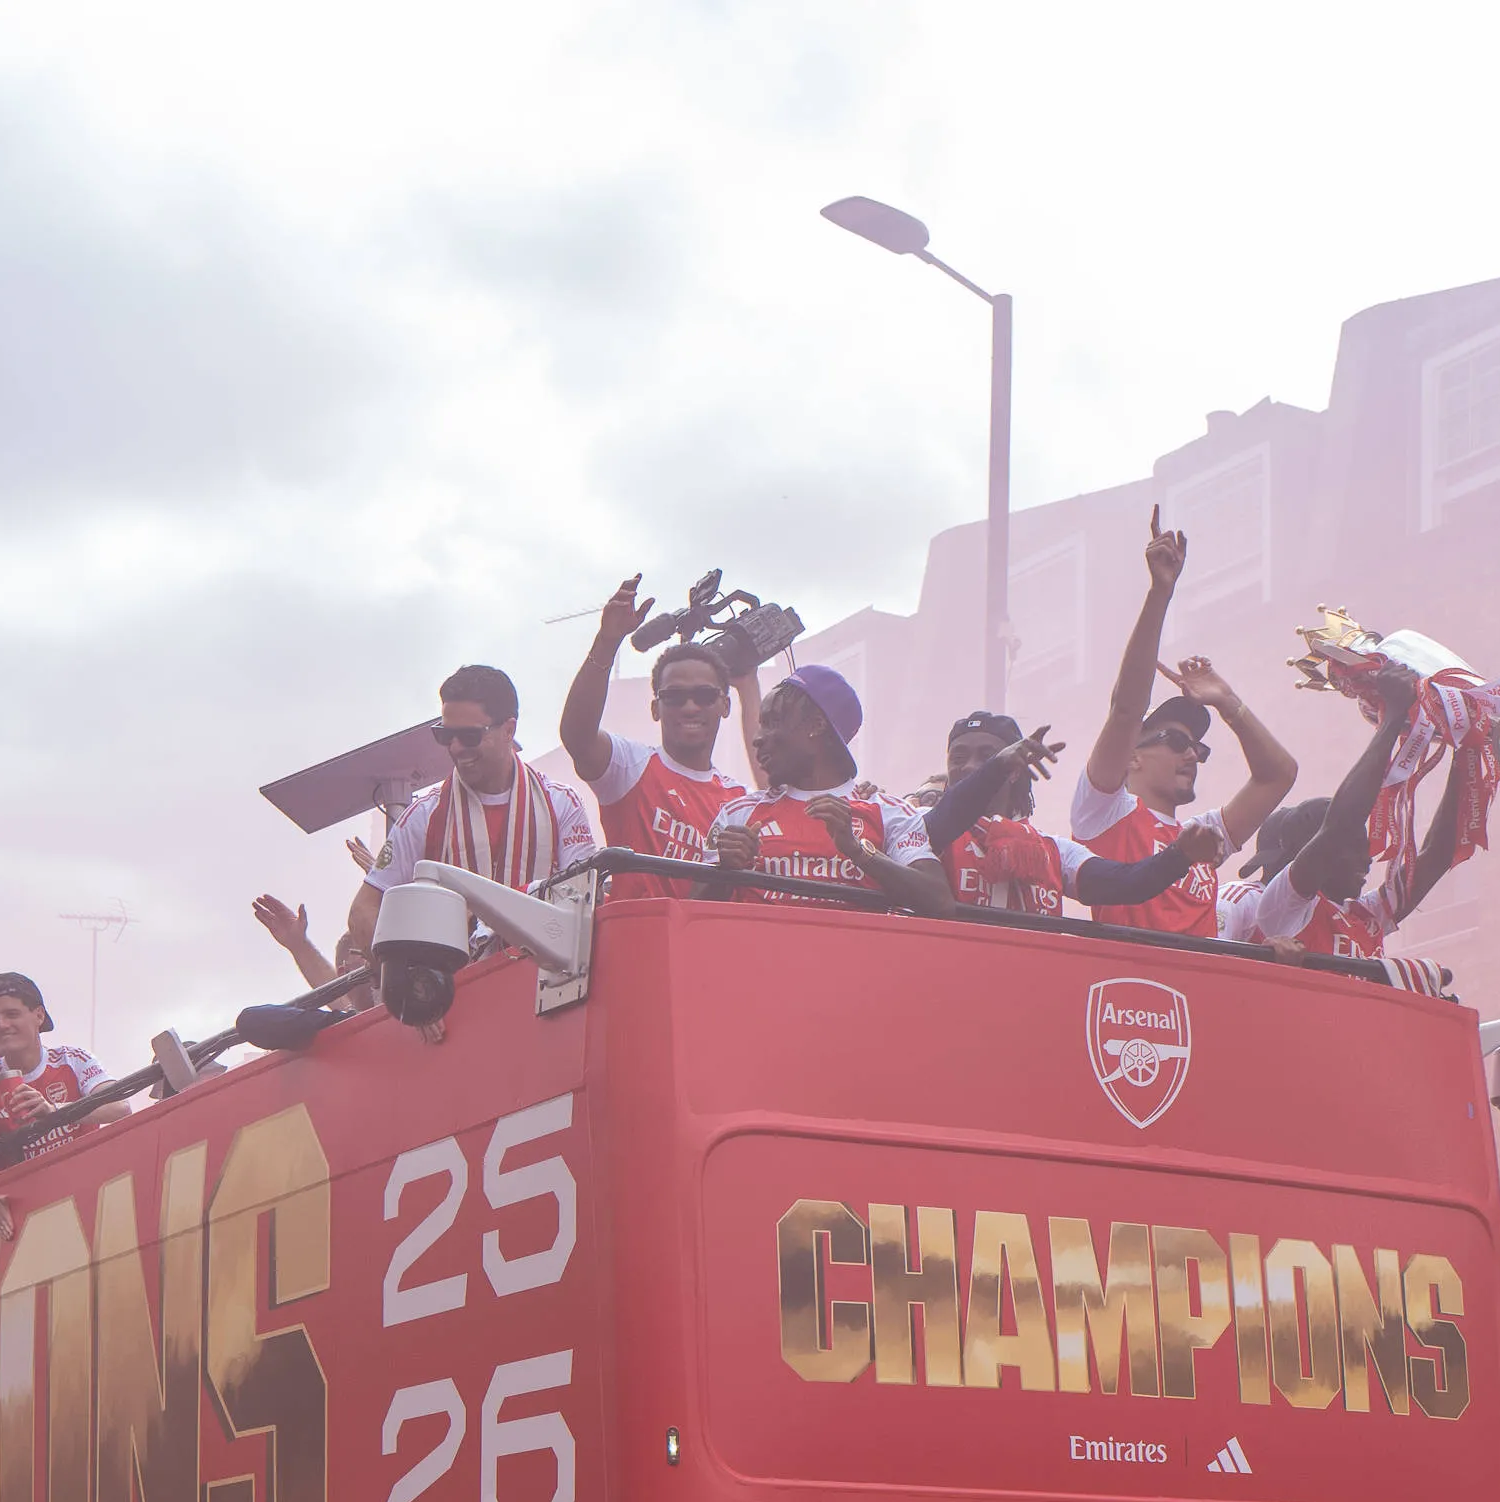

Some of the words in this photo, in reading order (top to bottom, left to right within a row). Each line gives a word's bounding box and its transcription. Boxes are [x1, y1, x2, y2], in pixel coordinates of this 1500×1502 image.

[1398, 729, 1428, 770] Premier
[754, 851, 865, 882] mirates
[1102, 1002, 1177, 1031] Arsenal
[383, 1091, 577, 1329] 25
[776, 1198, 1471, 1421] CHAMPIONS
[1068, 1435, 1169, 1465] Emirates
